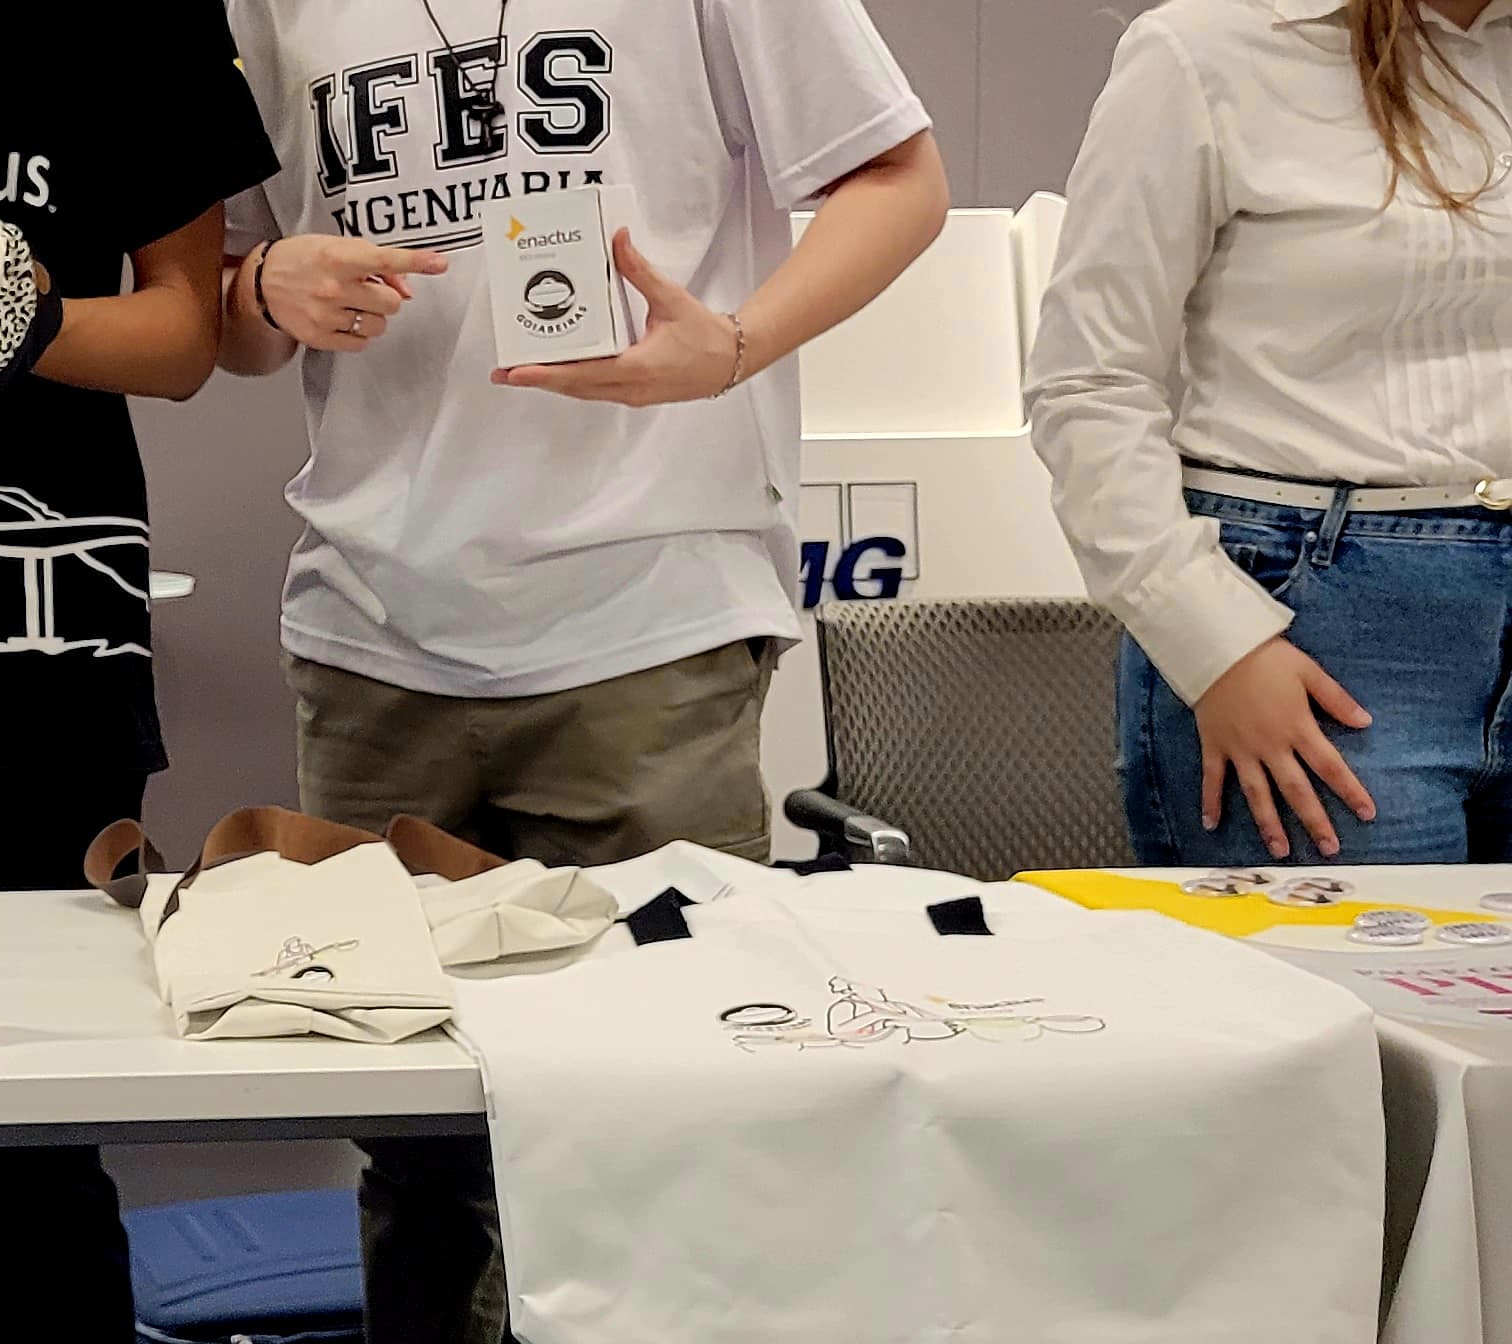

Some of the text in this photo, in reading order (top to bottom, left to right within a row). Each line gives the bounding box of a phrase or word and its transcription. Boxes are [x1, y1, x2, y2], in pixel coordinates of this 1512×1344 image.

[308, 29, 613, 198] IFES
[517, 229, 582, 250] enactus
[516, 305, 588, 334] GOIABEIRAS
